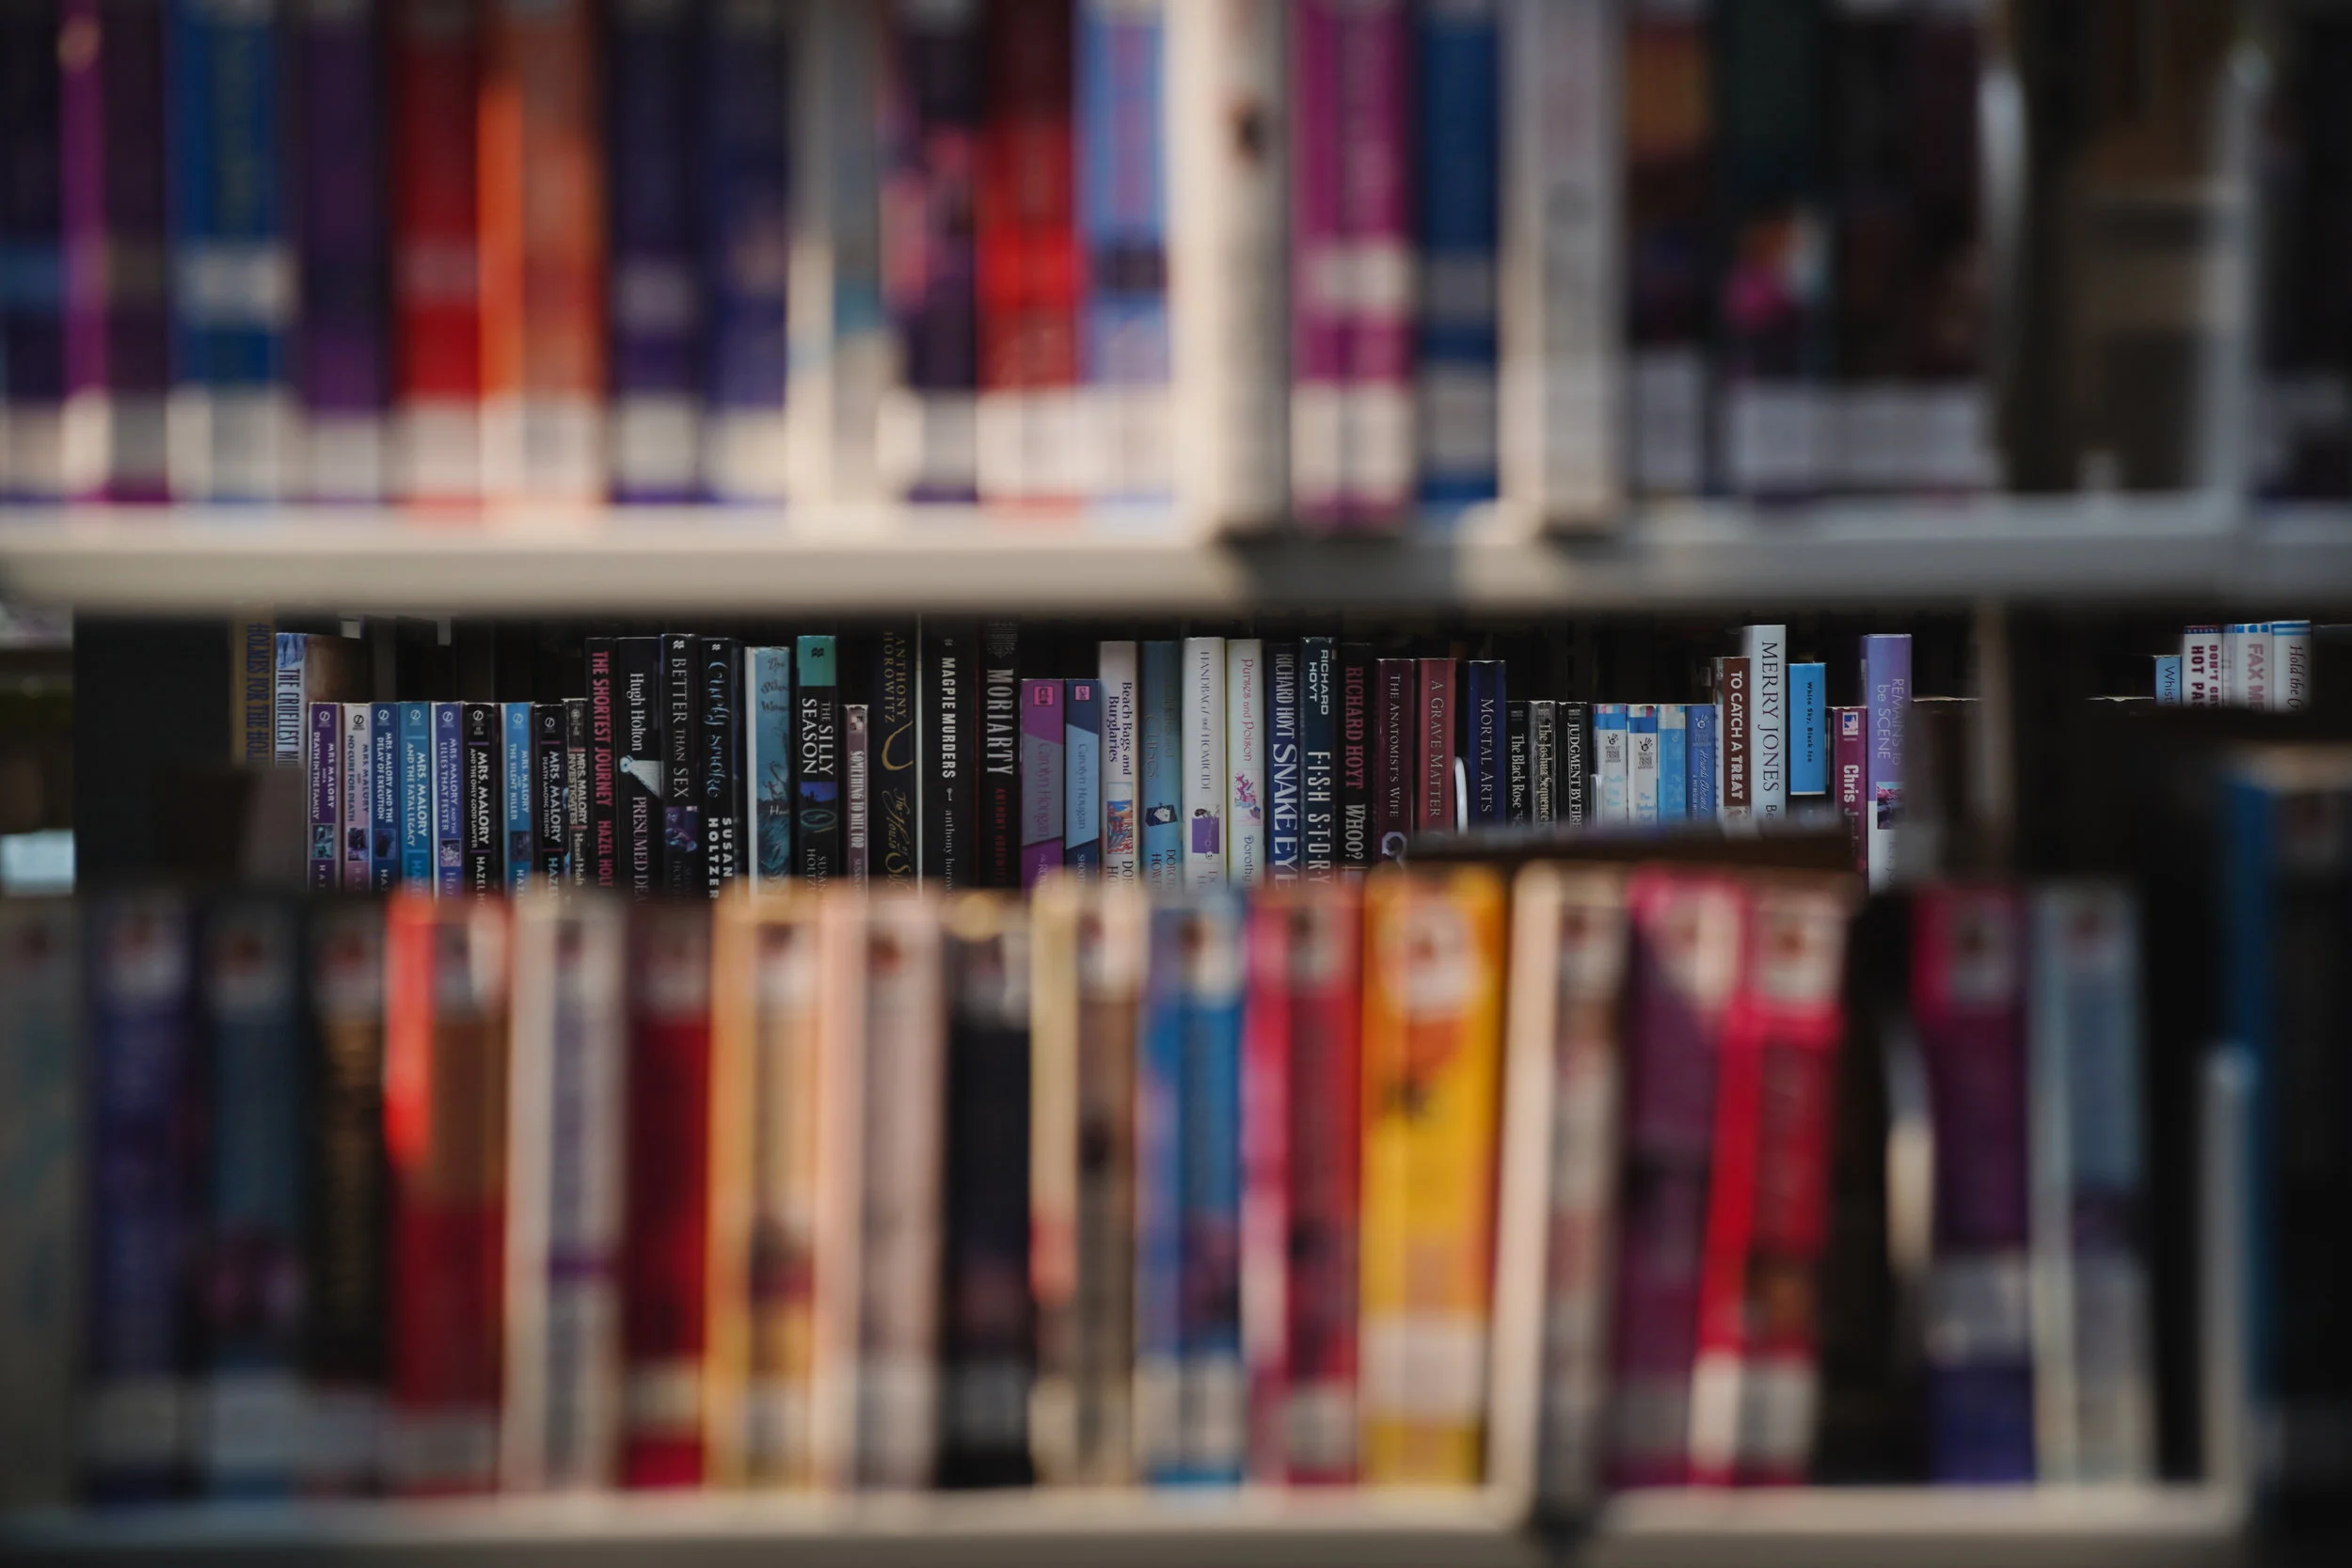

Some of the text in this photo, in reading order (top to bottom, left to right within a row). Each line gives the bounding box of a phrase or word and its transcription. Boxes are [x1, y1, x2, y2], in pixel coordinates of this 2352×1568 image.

[246, 678, 269, 702] FOR
[278, 669, 300, 687] THE
[705, 661, 730, 726] Curly
[883, 631, 895, 723] HOROWITZ
[896, 637, 907, 719] ANTHONY
[1320, 649, 1328, 715] RICHARD
[2192, 646, 2204, 673] HOT
[2209, 645, 2218, 681] DON'T
[2248, 644, 2264, 680] FAX
[2289, 645, 2306, 674] Hold
[2290, 678, 2302, 695] the
[246, 705, 269, 727] THE
[277, 693, 299, 746] CRUELLEST
[348, 736, 354, 748] NO
[672, 658, 688, 798] BETTER THAN SEX
[802, 698, 818, 774] SEASON
[818, 702, 834, 775] THE SILLY
[986, 669, 1013, 775] MORIARTY
[1106, 696, 1120, 763] Burglaries
[1120, 682, 1132, 775] Beach Bags and
[1201, 718, 1211, 731] and
[1273, 653, 1296, 831] RICHARD HOYT SNAKE
[1390, 673, 1400, 817] THE ANATOMIST'S WIFE
[1429, 680, 1443, 816] A GRAVE MATTER
[1731, 671, 1742, 799] TO CATCH A TREAT
[1758, 641, 1778, 791] MERRY JONES
[1877, 685, 1891, 759] be SCENE
[1892, 679, 1903, 766] REMAINS to
[312, 761, 320, 769] IN
[377, 764, 384, 773] OF
[450, 764, 458, 804] MALORY
[568, 753, 578, 825] INVESTIGATES
[593, 651, 613, 887] THE SHORTEST JOURNEY HAZEL HOLT
[627, 673, 647, 871] Hugh Holton PRESUMED
[942, 657, 956, 854] MAGPIE MURDERS anthony
[1034, 742, 1052, 837] Carolyn Hougan
[1077, 744, 1088, 829] Carolyn Hougan
[1200, 735, 1211, 792] HOMICIDE
[1241, 658, 1254, 881] Purses and Poison Dorothy
[1345, 666, 1366, 860] RICHARD HOYT WHOO?
[1480, 699, 1494, 812] MORTAL ARTS
[1512, 734, 1525, 808] The Black Rose
[1536, 722, 1551, 820] The Joshua Sequence
[1568, 723, 1581, 786] JUDGMENT
[1699, 750, 1708, 778] Hounds
[1844, 765, 1859, 802] Chris
[417, 752, 426, 837] MRS. MALORY
[477, 752, 488, 845] MRS. MALORY
[521, 773, 530, 813] MALORY
[549, 752, 561, 842] MRS. MALORY
[578, 780, 586, 824] MALORY
[850, 751, 865, 847] SOMETHING TO KILL FOR
[994, 788, 1006, 830] ANTHONY
[1571, 788, 1581, 801] BY
[406, 813, 415, 847] LEGACY
[575, 833, 583, 886] Hazel Holt
[707, 817, 719, 899] HOLTZER
[723, 817, 732, 878] SUSAN
[476, 856, 485, 890] HAZEL
